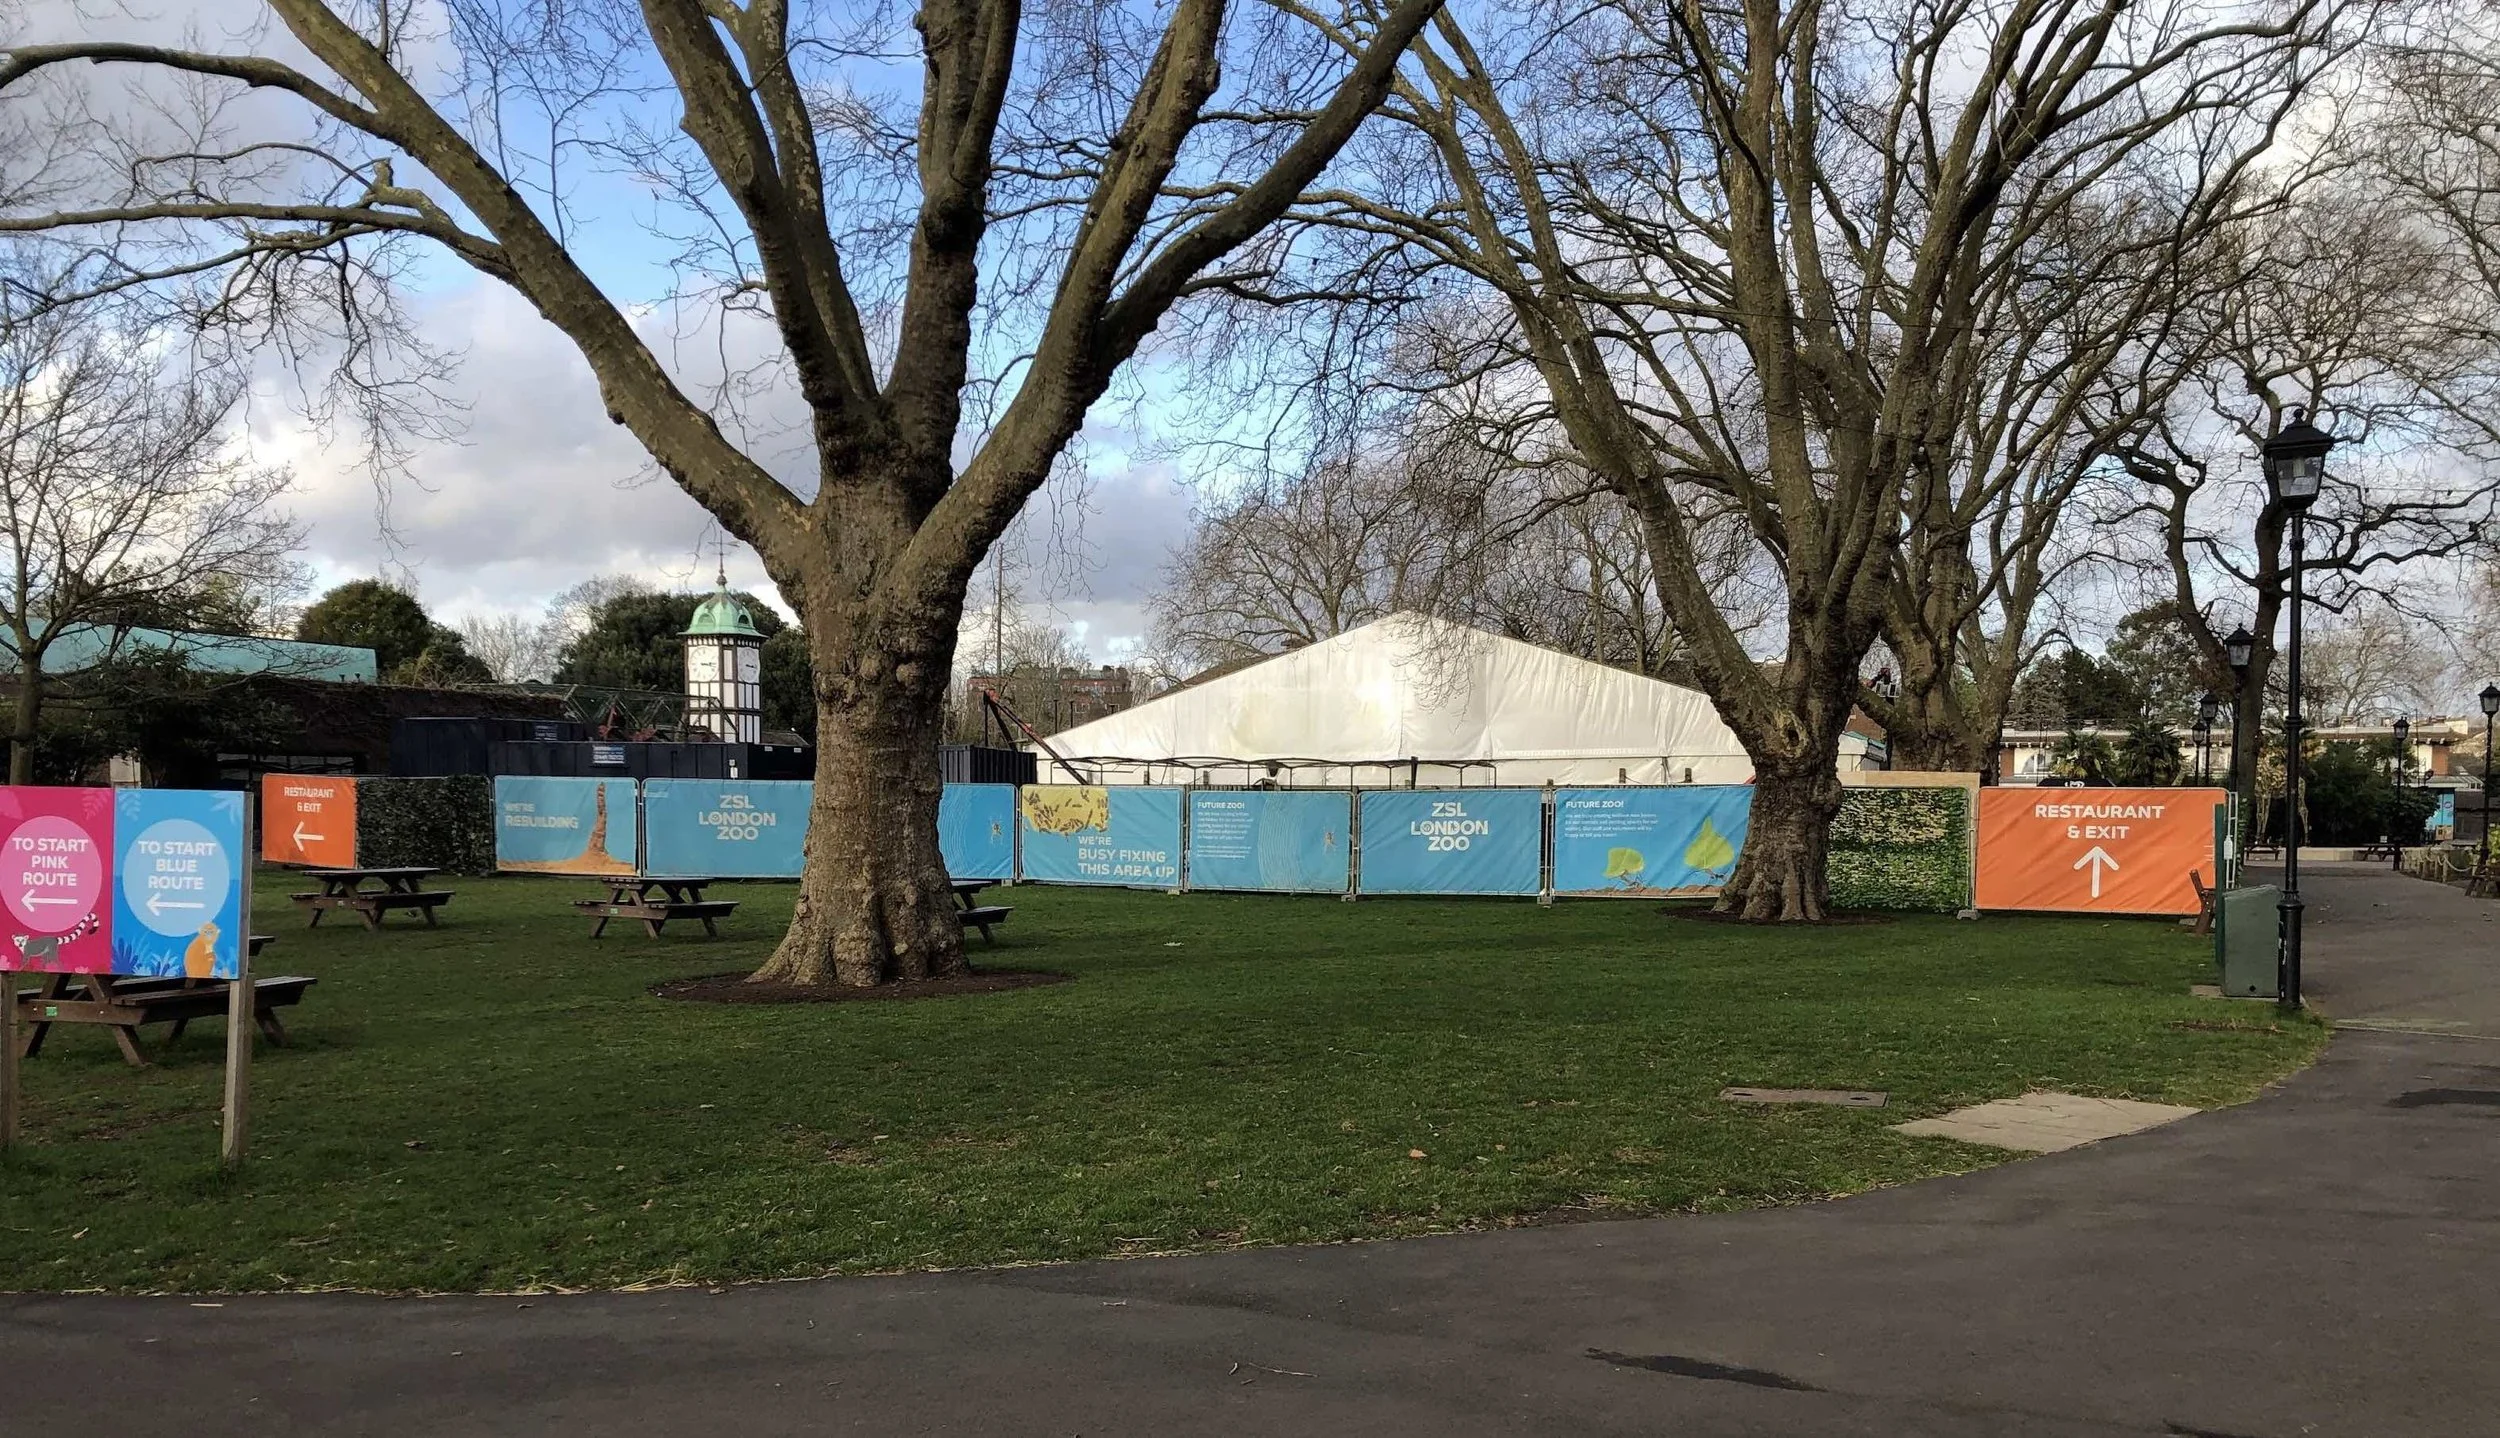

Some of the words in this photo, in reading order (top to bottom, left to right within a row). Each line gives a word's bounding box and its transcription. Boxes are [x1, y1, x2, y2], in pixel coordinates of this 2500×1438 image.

[283, 786, 335, 799] RESTAURANT
[296, 802, 303, 812] &
[303, 802, 322, 813] EXIT
[719, 794, 755, 809] ZSL
[1197, 801, 1226, 809] FUTURE
[1226, 801, 1246, 810] ZOO!
[1565, 800, 1601, 809] FUTURE
[1602, 800, 1625, 808] ZOO!
[1431, 802, 1468, 817] ZSL
[2034, 804, 2166, 819] RESTAURANT
[504, 814, 580, 829] REBUILDING
[698, 811, 777, 827] LONDON
[716, 826, 760, 841] ZOO
[1410, 820, 1489, 836] LONDON
[2066, 825, 2081, 840] &
[2085, 825, 2131, 840] EXIT
[12, 838, 35, 852] TO
[37, 838, 89, 852] START
[138, 840, 161, 855] TO
[164, 841, 217, 856] START
[1077, 835, 1112, 846] WE'RE
[1427, 836, 1470, 852] ZOO
[31, 855, 69, 869] PINK
[1078, 848, 1117, 861] BUSY
[1119, 849, 1167, 863] FIXING
[155, 858, 199, 873] BLUE
[1077, 862, 1110, 875] THIS
[1113, 864, 1153, 878] AREA
[1155, 866, 1175, 878] UP
[22, 872, 77, 887] ROUTE
[148, 875, 205, 891] ROUTE
